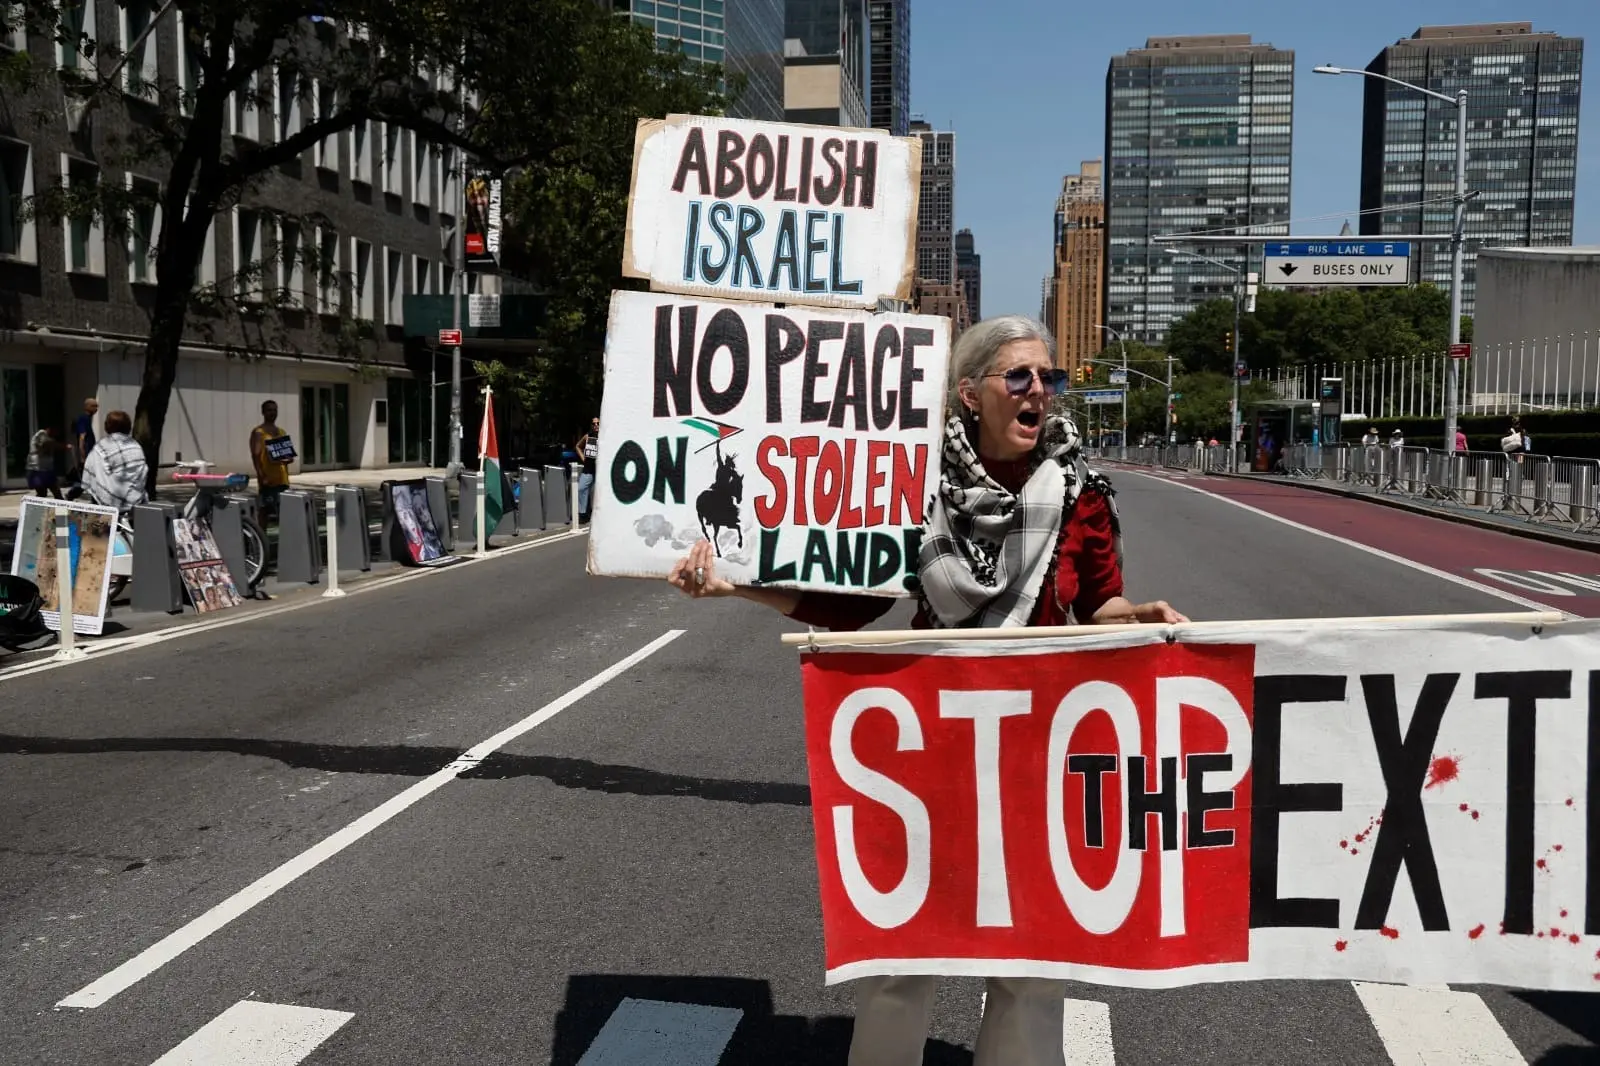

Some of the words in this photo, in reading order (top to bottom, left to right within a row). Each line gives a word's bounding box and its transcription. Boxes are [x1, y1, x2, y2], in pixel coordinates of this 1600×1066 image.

[670, 126, 879, 210] ABOLISH
[488, 179, 502, 226] AMAZING
[487, 226, 500, 252] STAY
[682, 200, 864, 296] ISRAEL
[1308, 245, 1328, 254] BUS
[1337, 245, 1366, 254] LANE
[1313, 264, 1355, 275] BUSES
[1360, 264, 1394, 275] ONLY
[652, 304, 751, 418] NO
[764, 313, 935, 432] PEACE
[610, 435, 689, 505] ON
[753, 435, 929, 530] STOLEN
[758, 528, 921, 592] LAND!
[1472, 568, 1600, 596] ON
[829, 674, 1253, 938] STOP
[1067, 752, 1235, 851] THE
[1250, 671, 1600, 935] EXT
